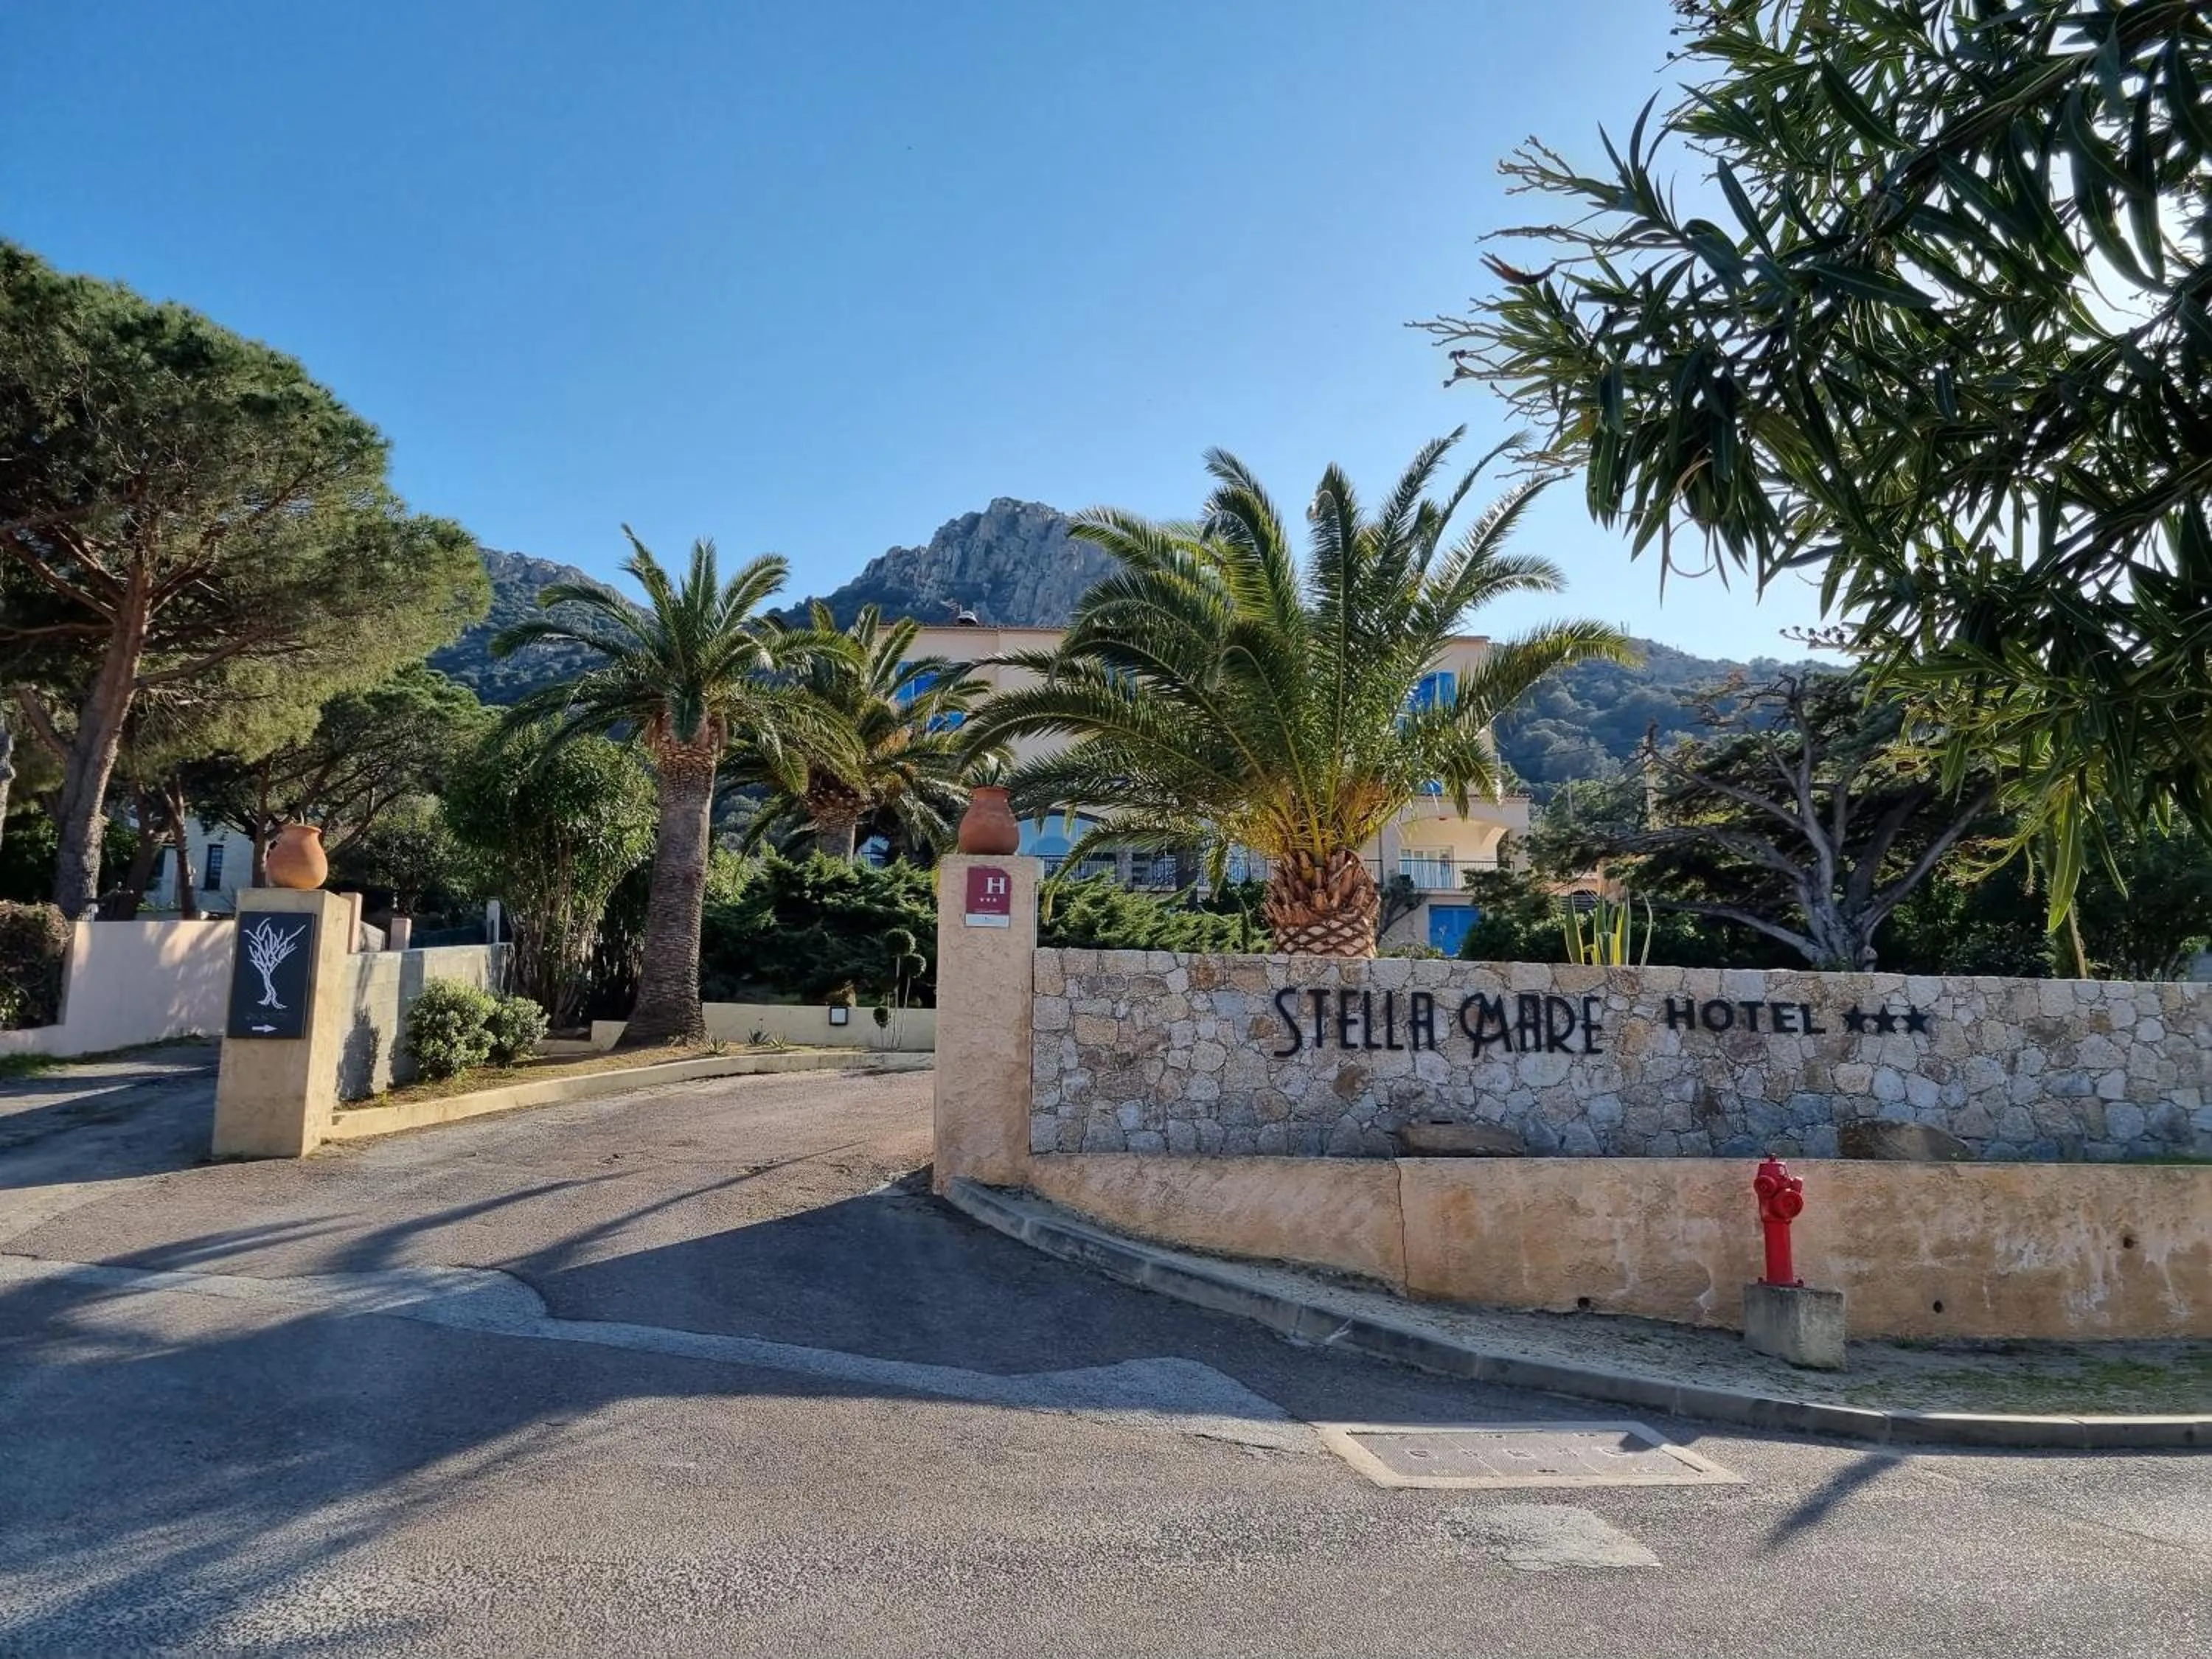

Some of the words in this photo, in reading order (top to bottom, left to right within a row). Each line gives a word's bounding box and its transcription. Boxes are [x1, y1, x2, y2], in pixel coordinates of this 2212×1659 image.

[987, 877, 1005, 894] H
[1273, 987, 1436, 1058] STELLA
[1459, 992, 1604, 1059] MARE
[1665, 998, 1826, 1035] HOTEL
